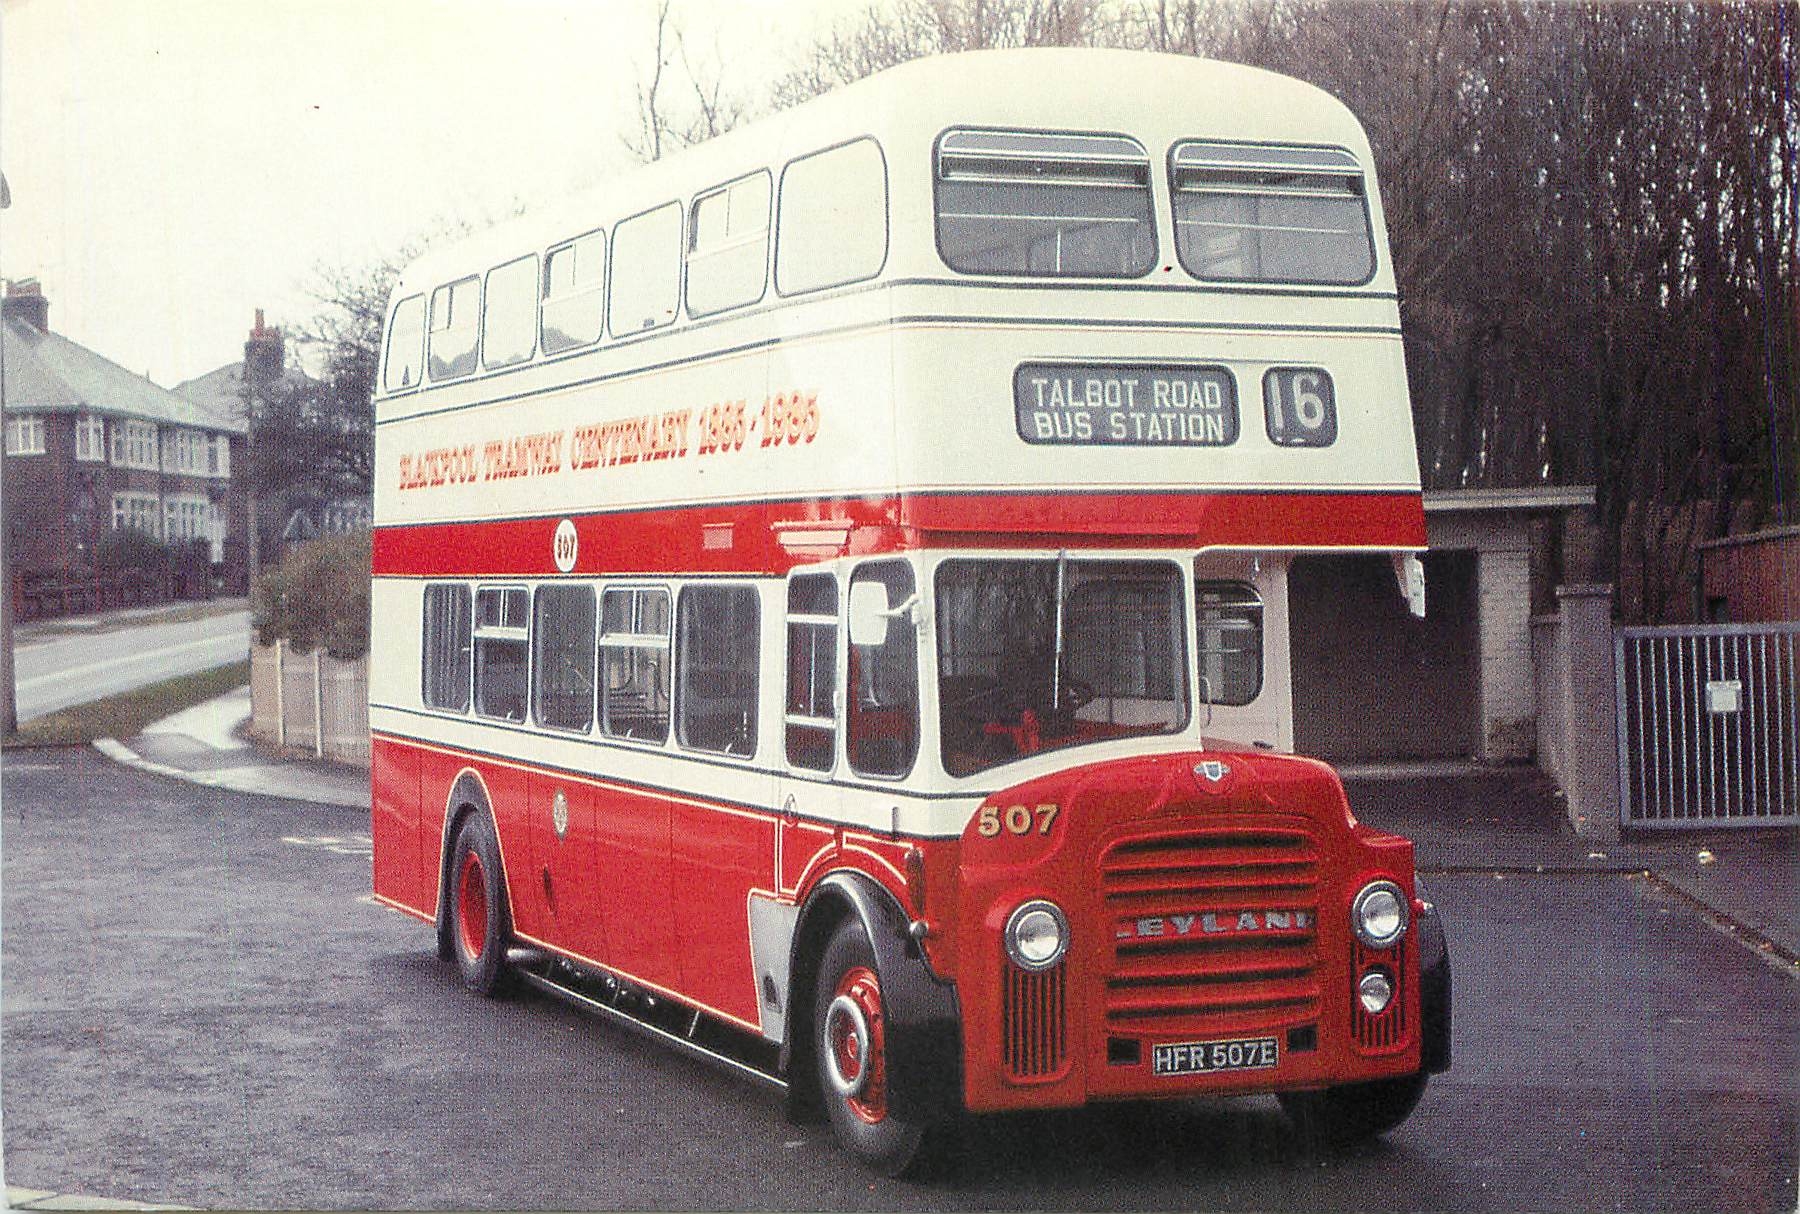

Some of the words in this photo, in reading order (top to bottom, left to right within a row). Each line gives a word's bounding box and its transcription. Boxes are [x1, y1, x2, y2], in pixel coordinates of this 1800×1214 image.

[1032, 379, 1138, 408] TALBOT
[1153, 379, 1221, 410] ROAD
[1269, 370, 1325, 430] 16
[1034, 412, 1092, 439] BUS
[1110, 412, 1224, 442] STATION
[399, 444, 478, 490] BLACKPOOL
[483, 430, 565, 481] TRAMWAY
[570, 408, 692, 470] CENTENARY
[978, 804, 1060, 837] 507
[1116, 910, 1314, 939] EYLAN
[1156, 1046, 1205, 1072] HFR
[1212, 1041, 1275, 1067] 507E
